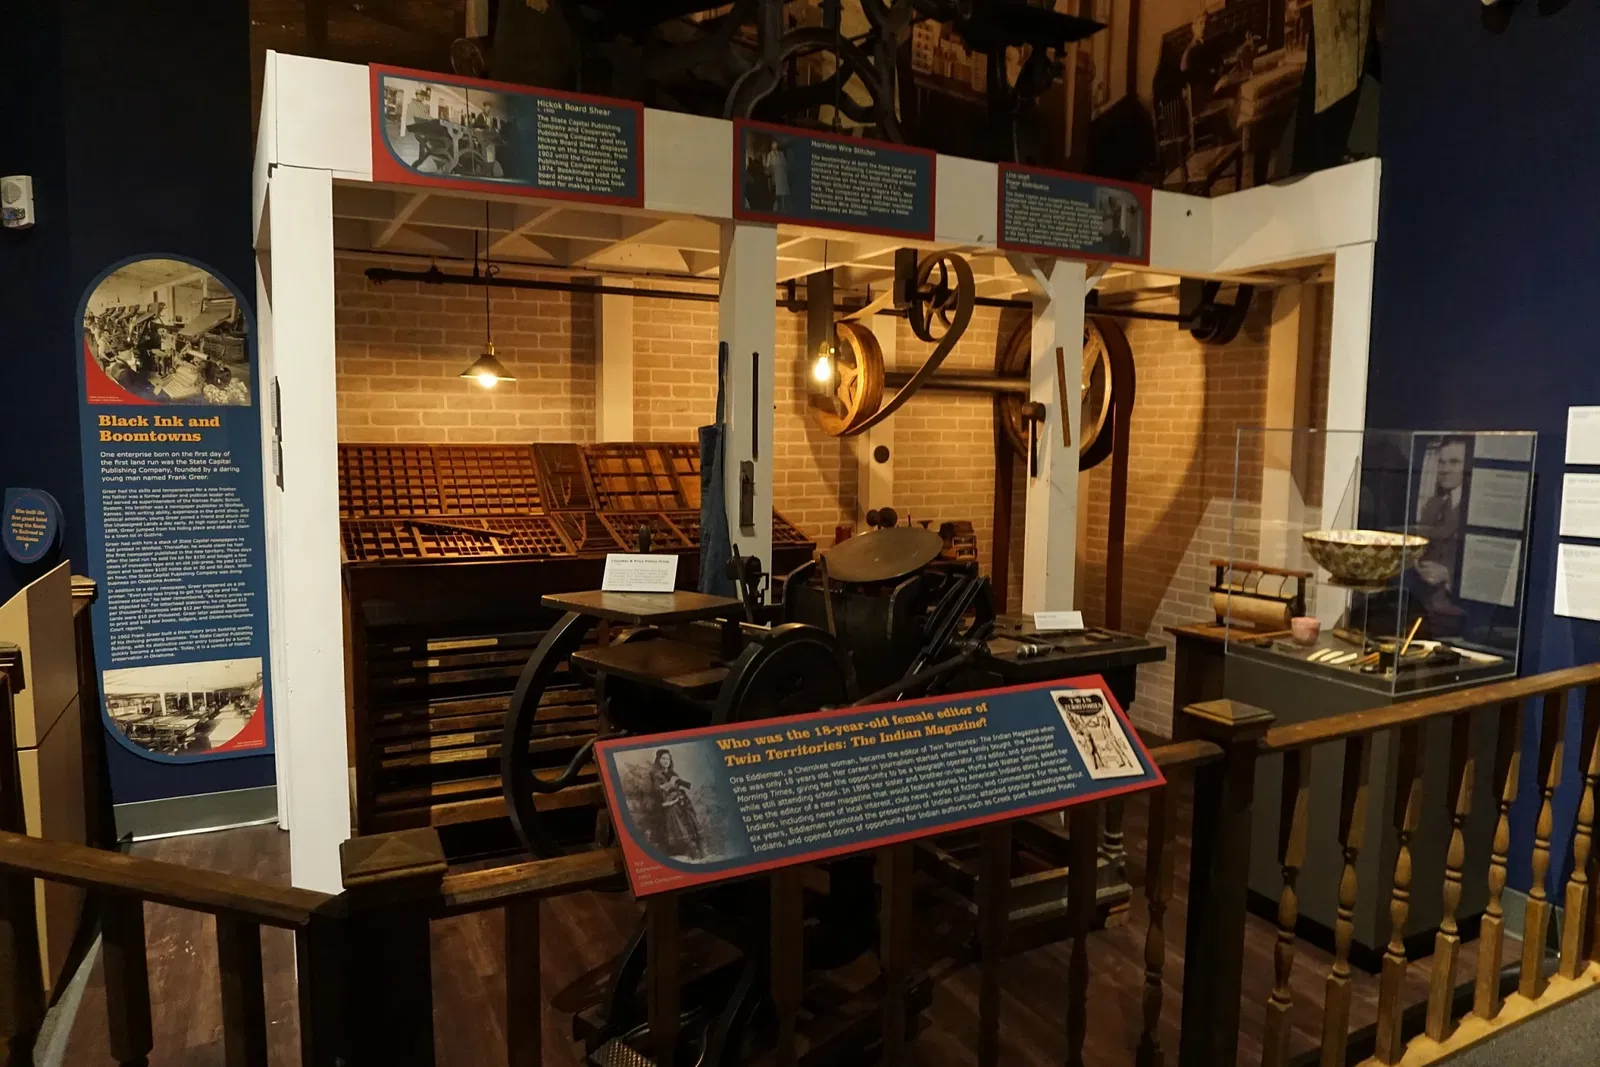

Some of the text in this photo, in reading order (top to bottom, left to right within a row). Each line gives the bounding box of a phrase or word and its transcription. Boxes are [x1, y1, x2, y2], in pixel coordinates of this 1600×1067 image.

[537, 100, 562, 109] Hickok
[565, 103, 587, 112] Board
[589, 107, 610, 116] Shear
[99, 415, 220, 427] Black Ink and
[100, 430, 201, 442] Boomtowns
[717, 703, 987, 750] Who was the 18-year-old female editor of
[725, 718, 986, 766] Twin Territories: The Indian Magazine?
[746, 771, 786, 781] Eddleman,
[794, 763, 828, 773] Cherokee
[830, 759, 858, 767] woman,
[859, 754, 886, 763] became
[766, 780, 782, 788] only
[796, 775, 816, 784] years
[848, 766, 869, 774] career
[737, 793, 768, 802] Morning
[770, 788, 795, 797] Times,
[796, 784, 819, 794] giving
[848, 772, 887, 783] opportunity
[740, 804, 760, 812] while
[762, 800, 776, 809] still
[778, 795, 813, 806] attending
[815, 789, 840, 799] school.
[852, 783, 870, 792] 1898
[746, 822, 778, 832] Indians,
[780, 814, 814, 825] including
[845, 804, 863, 813] local
[780, 807, 801, 816] editor
[838, 794, 871, 804] magazine
[753, 841, 785, 852] Indians,
[788, 836, 802, 845] and
[804, 830, 832, 842] opened
[834, 827, 854, 836] doors
[763, 831, 788, 841] years,
[789, 823, 827, 834] Eddleman
[828, 814, 863, 828] promoted
